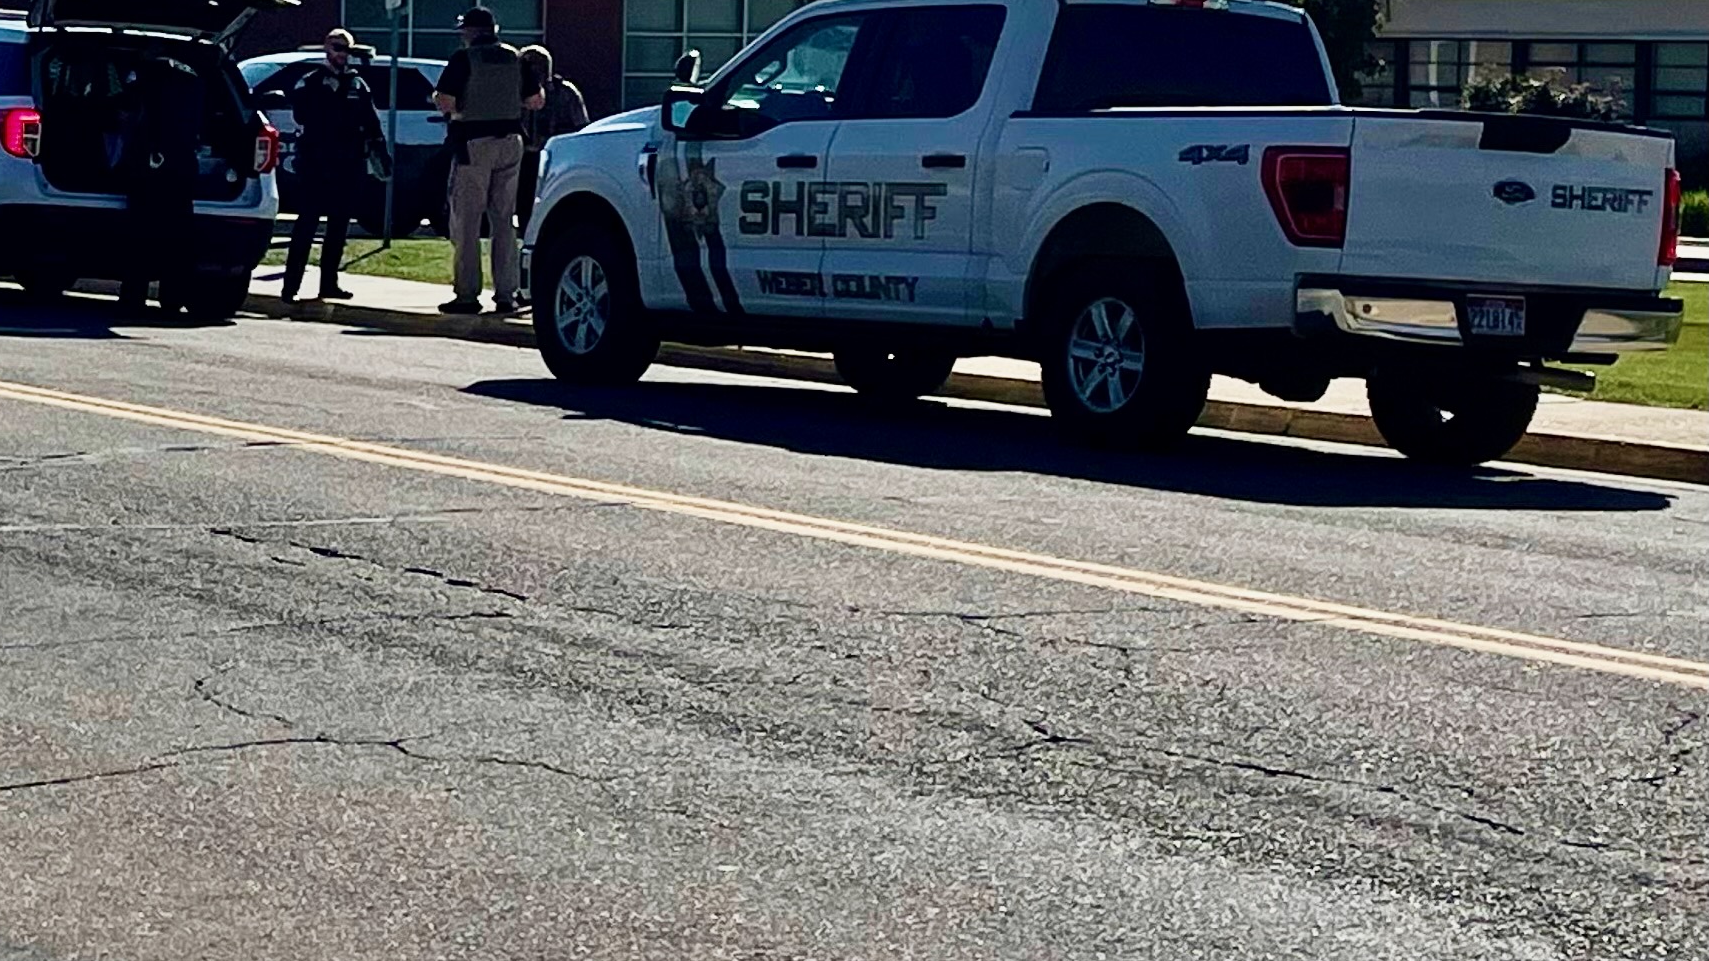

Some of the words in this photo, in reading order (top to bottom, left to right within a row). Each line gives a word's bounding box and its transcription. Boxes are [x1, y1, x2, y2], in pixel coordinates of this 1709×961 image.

[739, 180, 948, 240] SHERIFF
[1551, 184, 1653, 213] SHERIFF
[755, 269, 827, 298] WEBER
[831, 273, 919, 303] COUNTY
